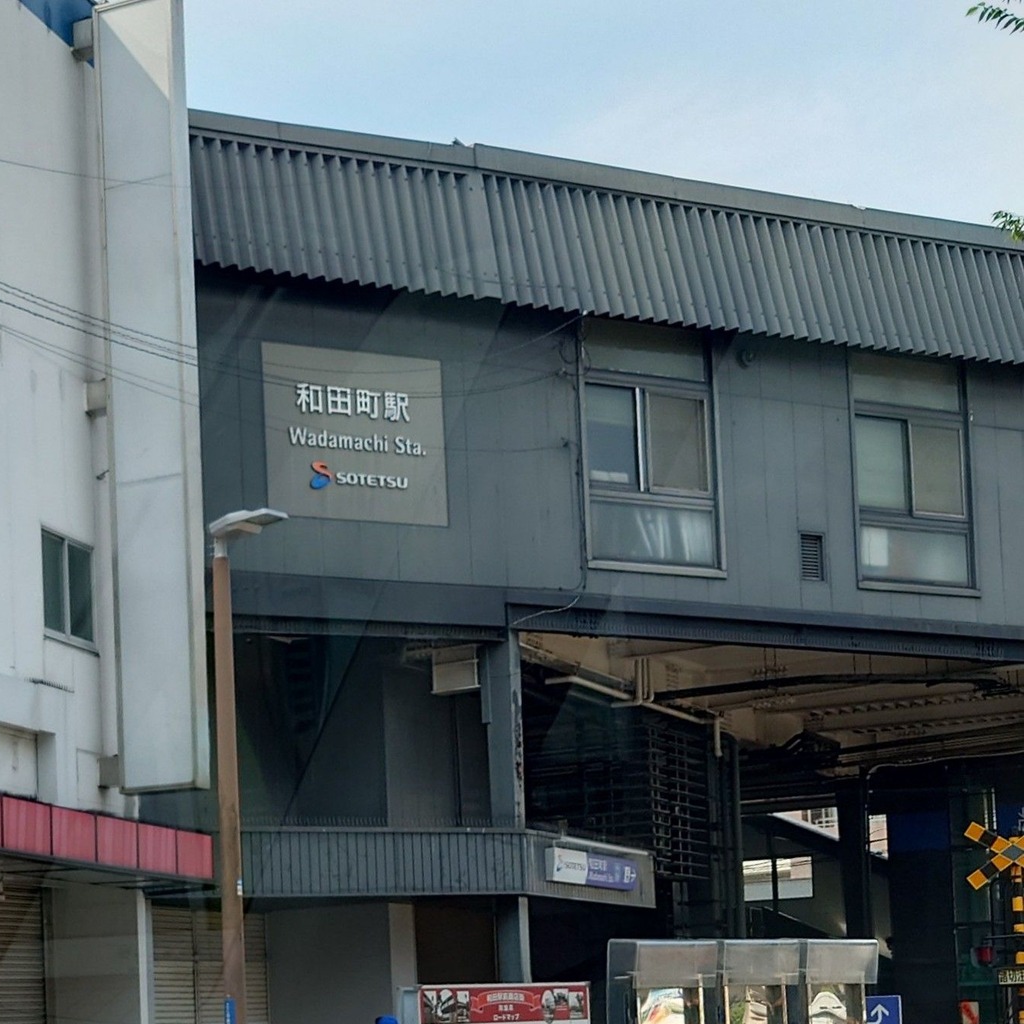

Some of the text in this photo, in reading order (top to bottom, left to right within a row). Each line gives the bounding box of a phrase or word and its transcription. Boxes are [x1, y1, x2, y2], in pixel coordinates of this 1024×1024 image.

[296, 383, 410, 422] 和田町駅
[288, 426, 426, 456] Wadamachi Sta.
[336, 472, 408, 489] SOTETSU
